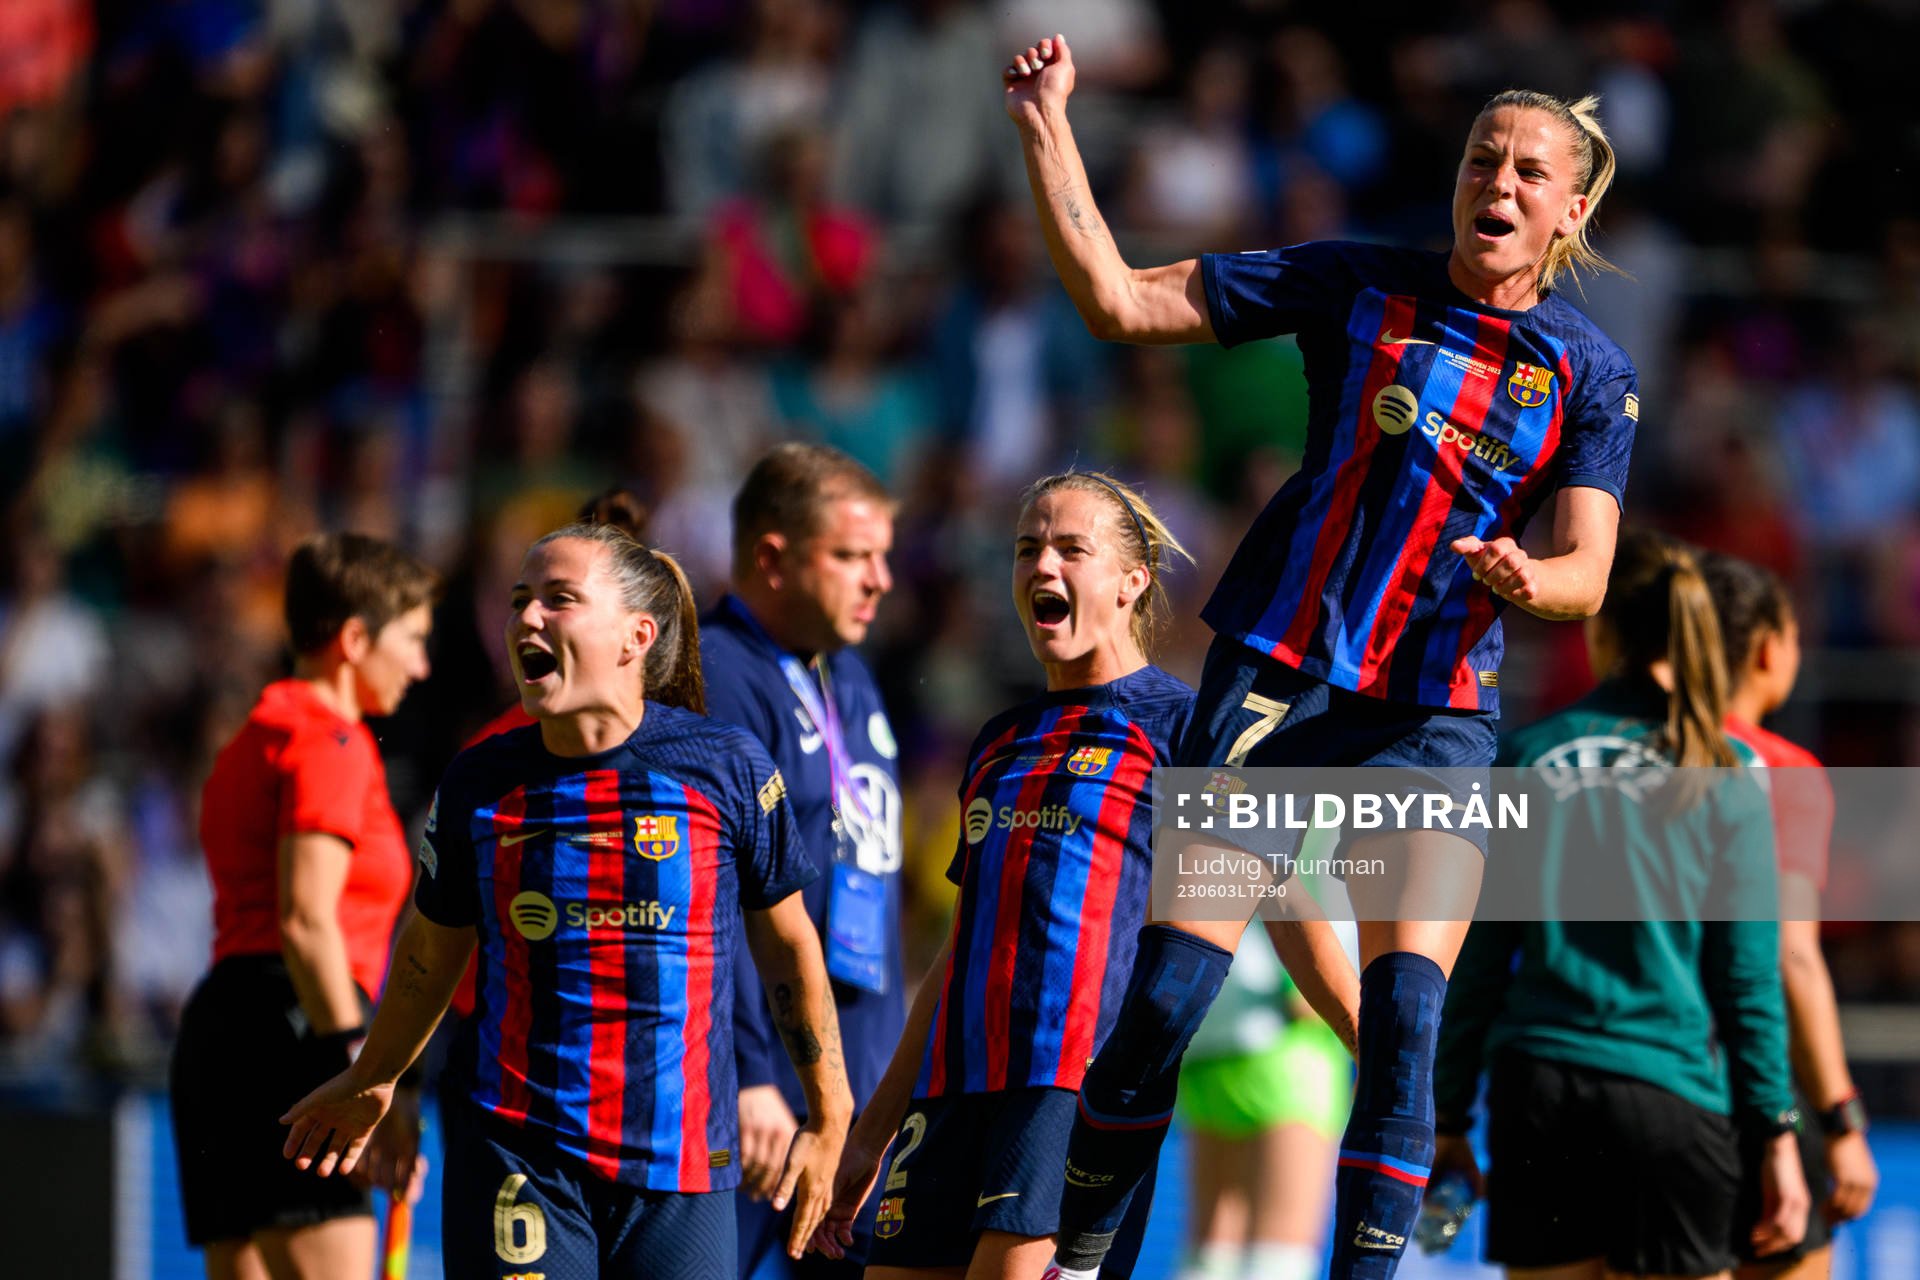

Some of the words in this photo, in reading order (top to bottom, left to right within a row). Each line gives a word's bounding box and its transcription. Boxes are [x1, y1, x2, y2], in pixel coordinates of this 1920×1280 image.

[1421, 411, 1521, 472] Spotify
[1224, 691, 1291, 769] 7
[996, 804, 1083, 836] Spotify
[565, 900, 676, 932] Spotify
[884, 1112, 927, 1192] 2
[493, 1173, 548, 1264] 6
